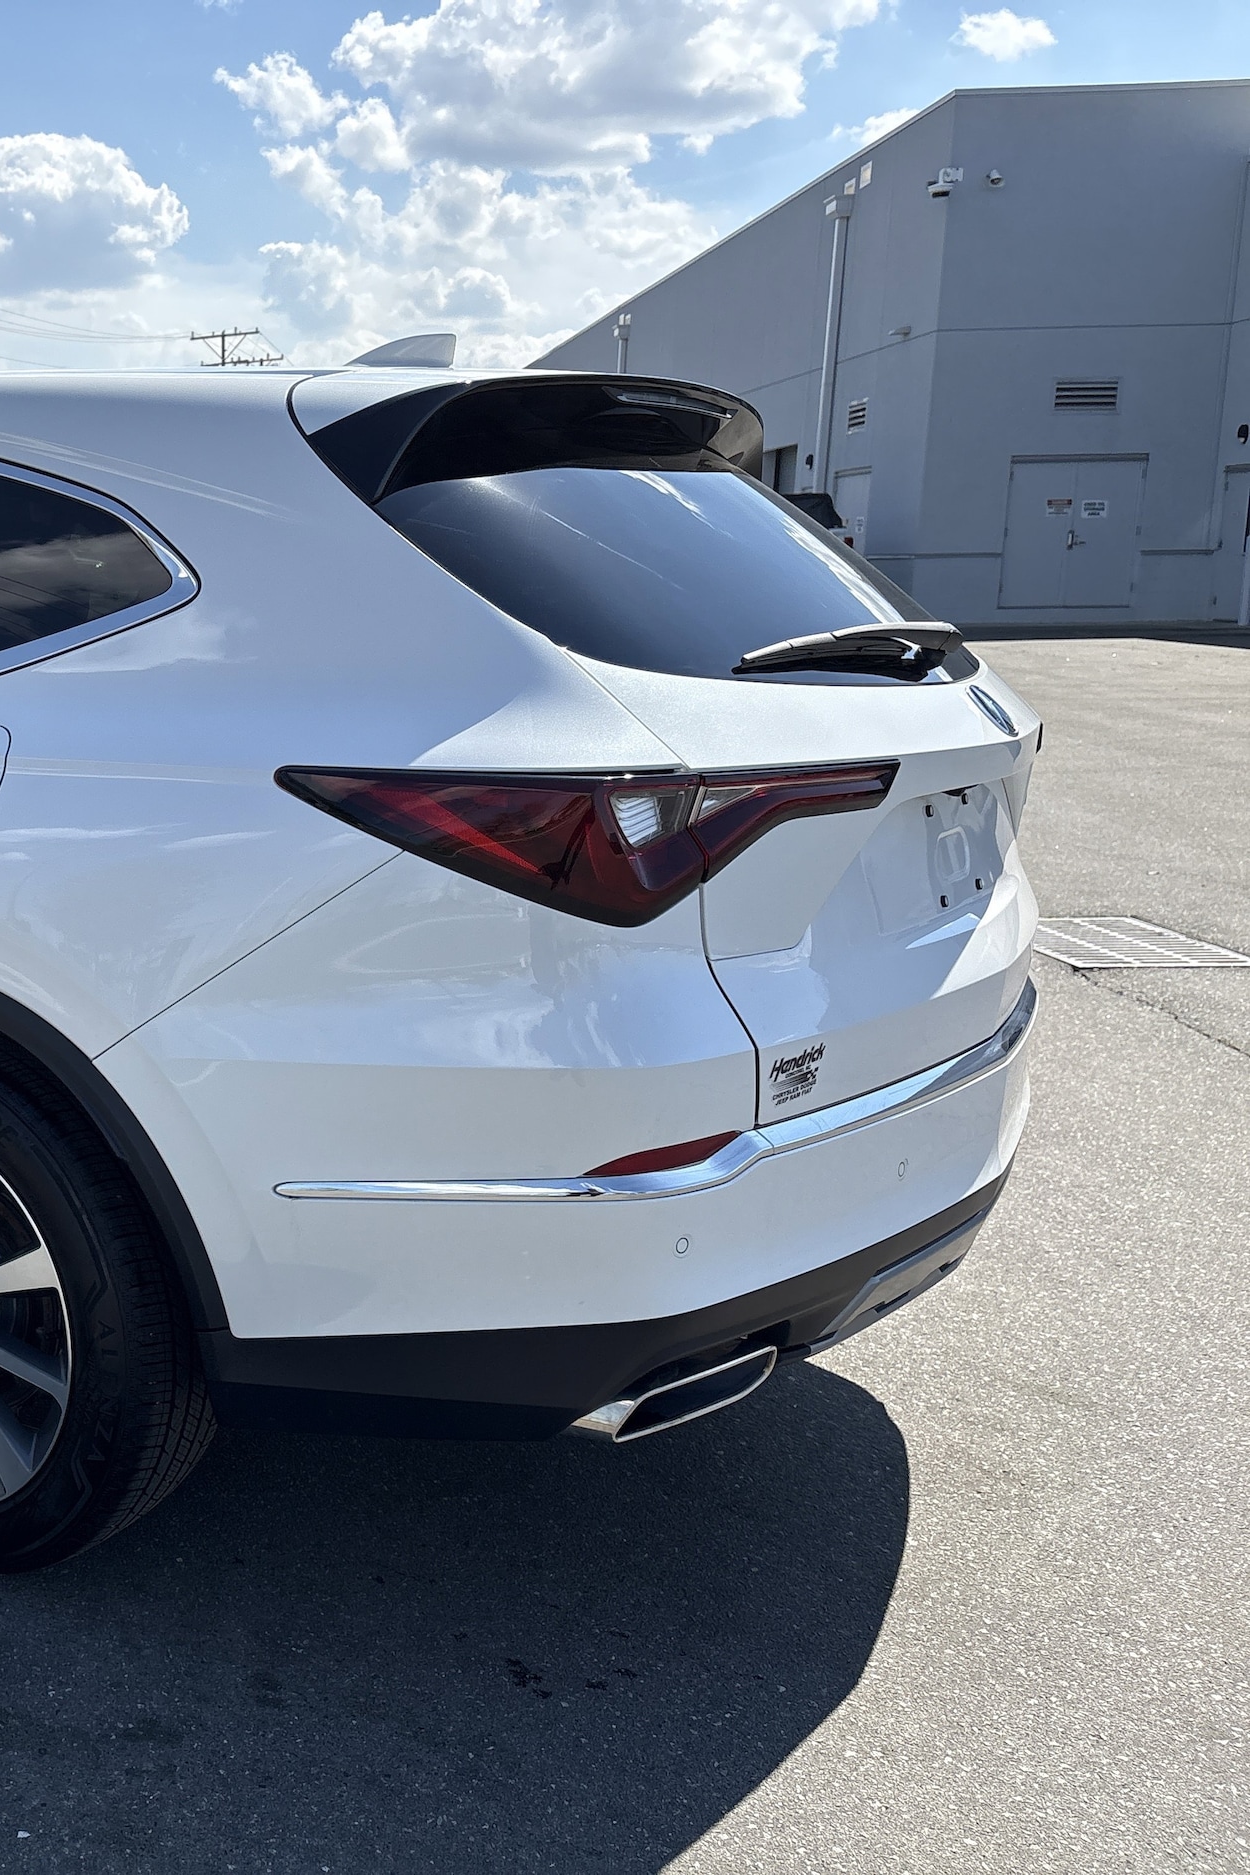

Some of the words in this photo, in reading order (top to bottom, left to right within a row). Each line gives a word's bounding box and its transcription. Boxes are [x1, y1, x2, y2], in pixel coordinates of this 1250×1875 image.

[769, 1042, 826, 1081] Hendrick
[773, 1087, 799, 1100] CHRYSLER
[800, 1079, 817, 1090] DODGE
[775, 1097, 789, 1106] JEEP
[790, 1092, 801, 1101] RAM
[801, 1087, 812, 1096] FIAT
